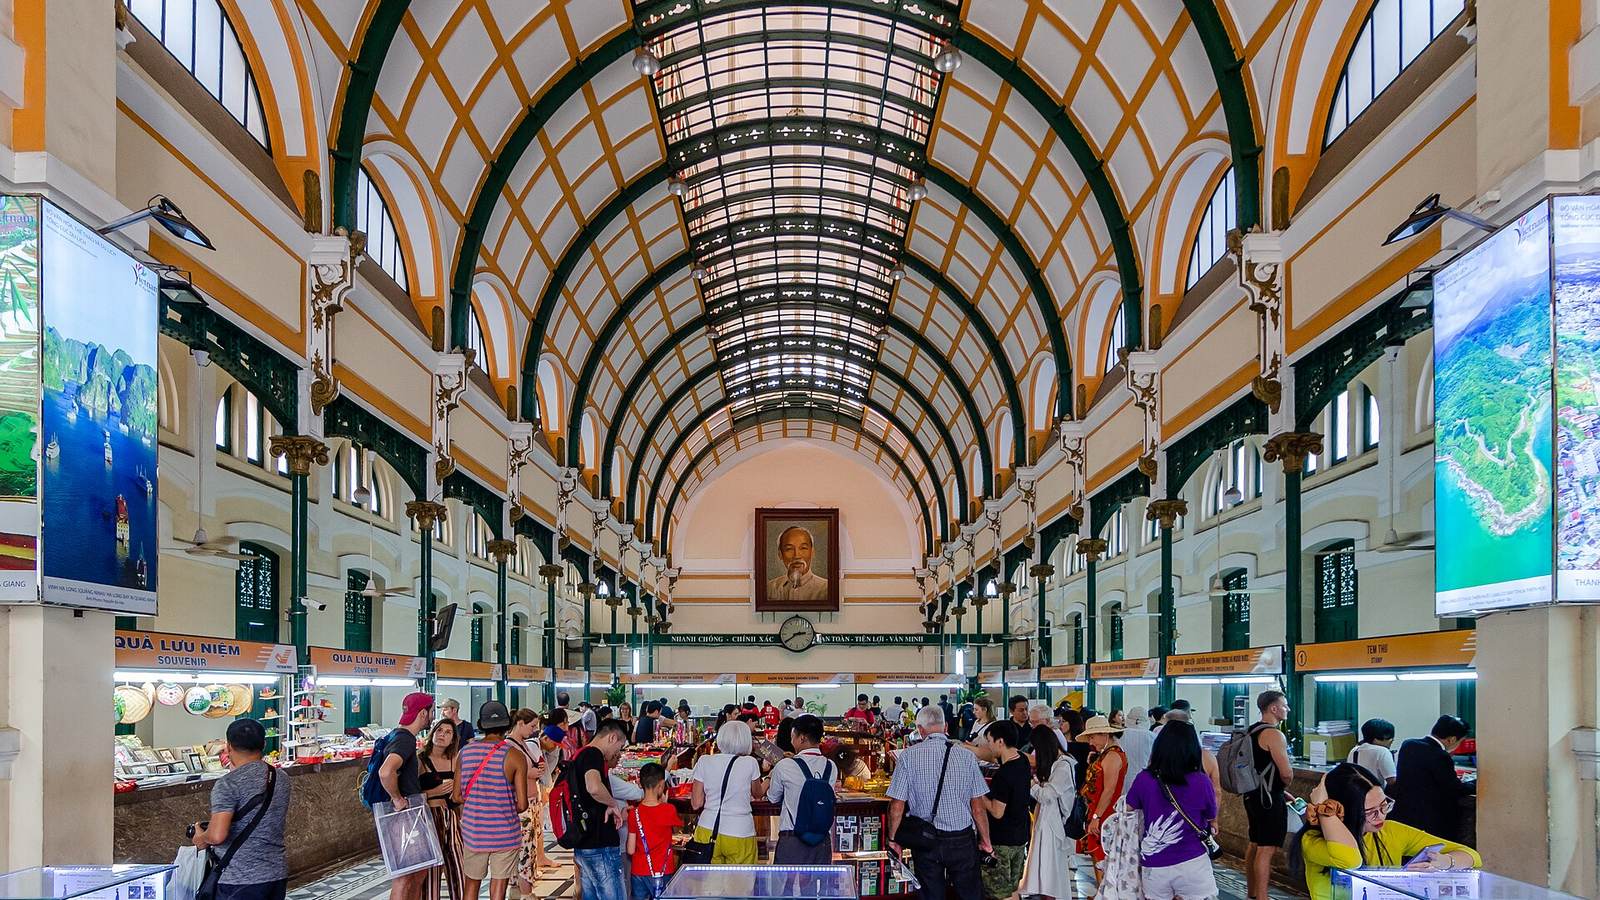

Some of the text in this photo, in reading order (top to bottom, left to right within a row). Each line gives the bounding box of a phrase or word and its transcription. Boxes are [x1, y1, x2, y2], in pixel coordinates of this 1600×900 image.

[160, 639, 195, 653] LƯU
[201, 643, 240, 658] NIỆM
[158, 655, 207, 666] SOUVENIR
